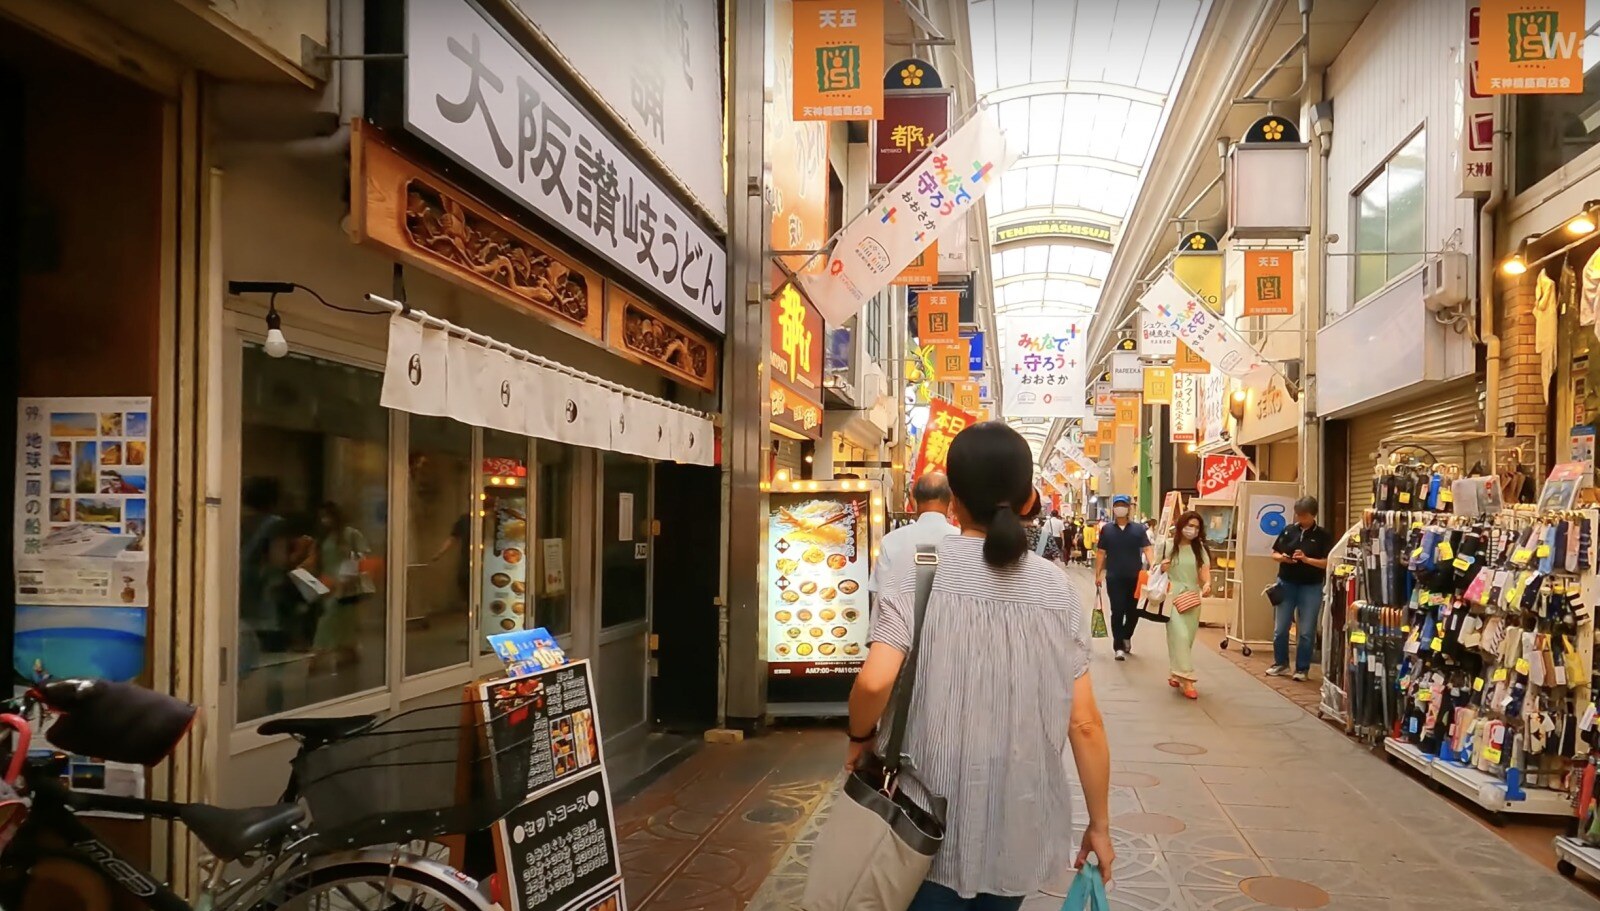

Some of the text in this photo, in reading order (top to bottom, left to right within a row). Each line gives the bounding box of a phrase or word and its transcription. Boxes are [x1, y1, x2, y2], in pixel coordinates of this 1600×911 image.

[819, 9, 857, 28] 天五
[933, 153, 972, 206] みんなで
[918, 170, 955, 216] 守ろう
[901, 191, 936, 230] おおさか
[1258, 256, 1280, 267] 天五
[930, 296, 948, 305] 天五
[1018, 333, 1070, 353] みんなで
[1023, 353, 1066, 373] 守ろう
[1021, 374, 1069, 386] おおさか
[934, 410, 966, 435] 本日
[1206, 456, 1229, 477] NEW
[1206, 460, 1242, 489] OPEN!!
[24, 433, 42, 554] 地球一周の船旅
[525, 795, 588, 837] セットコース
